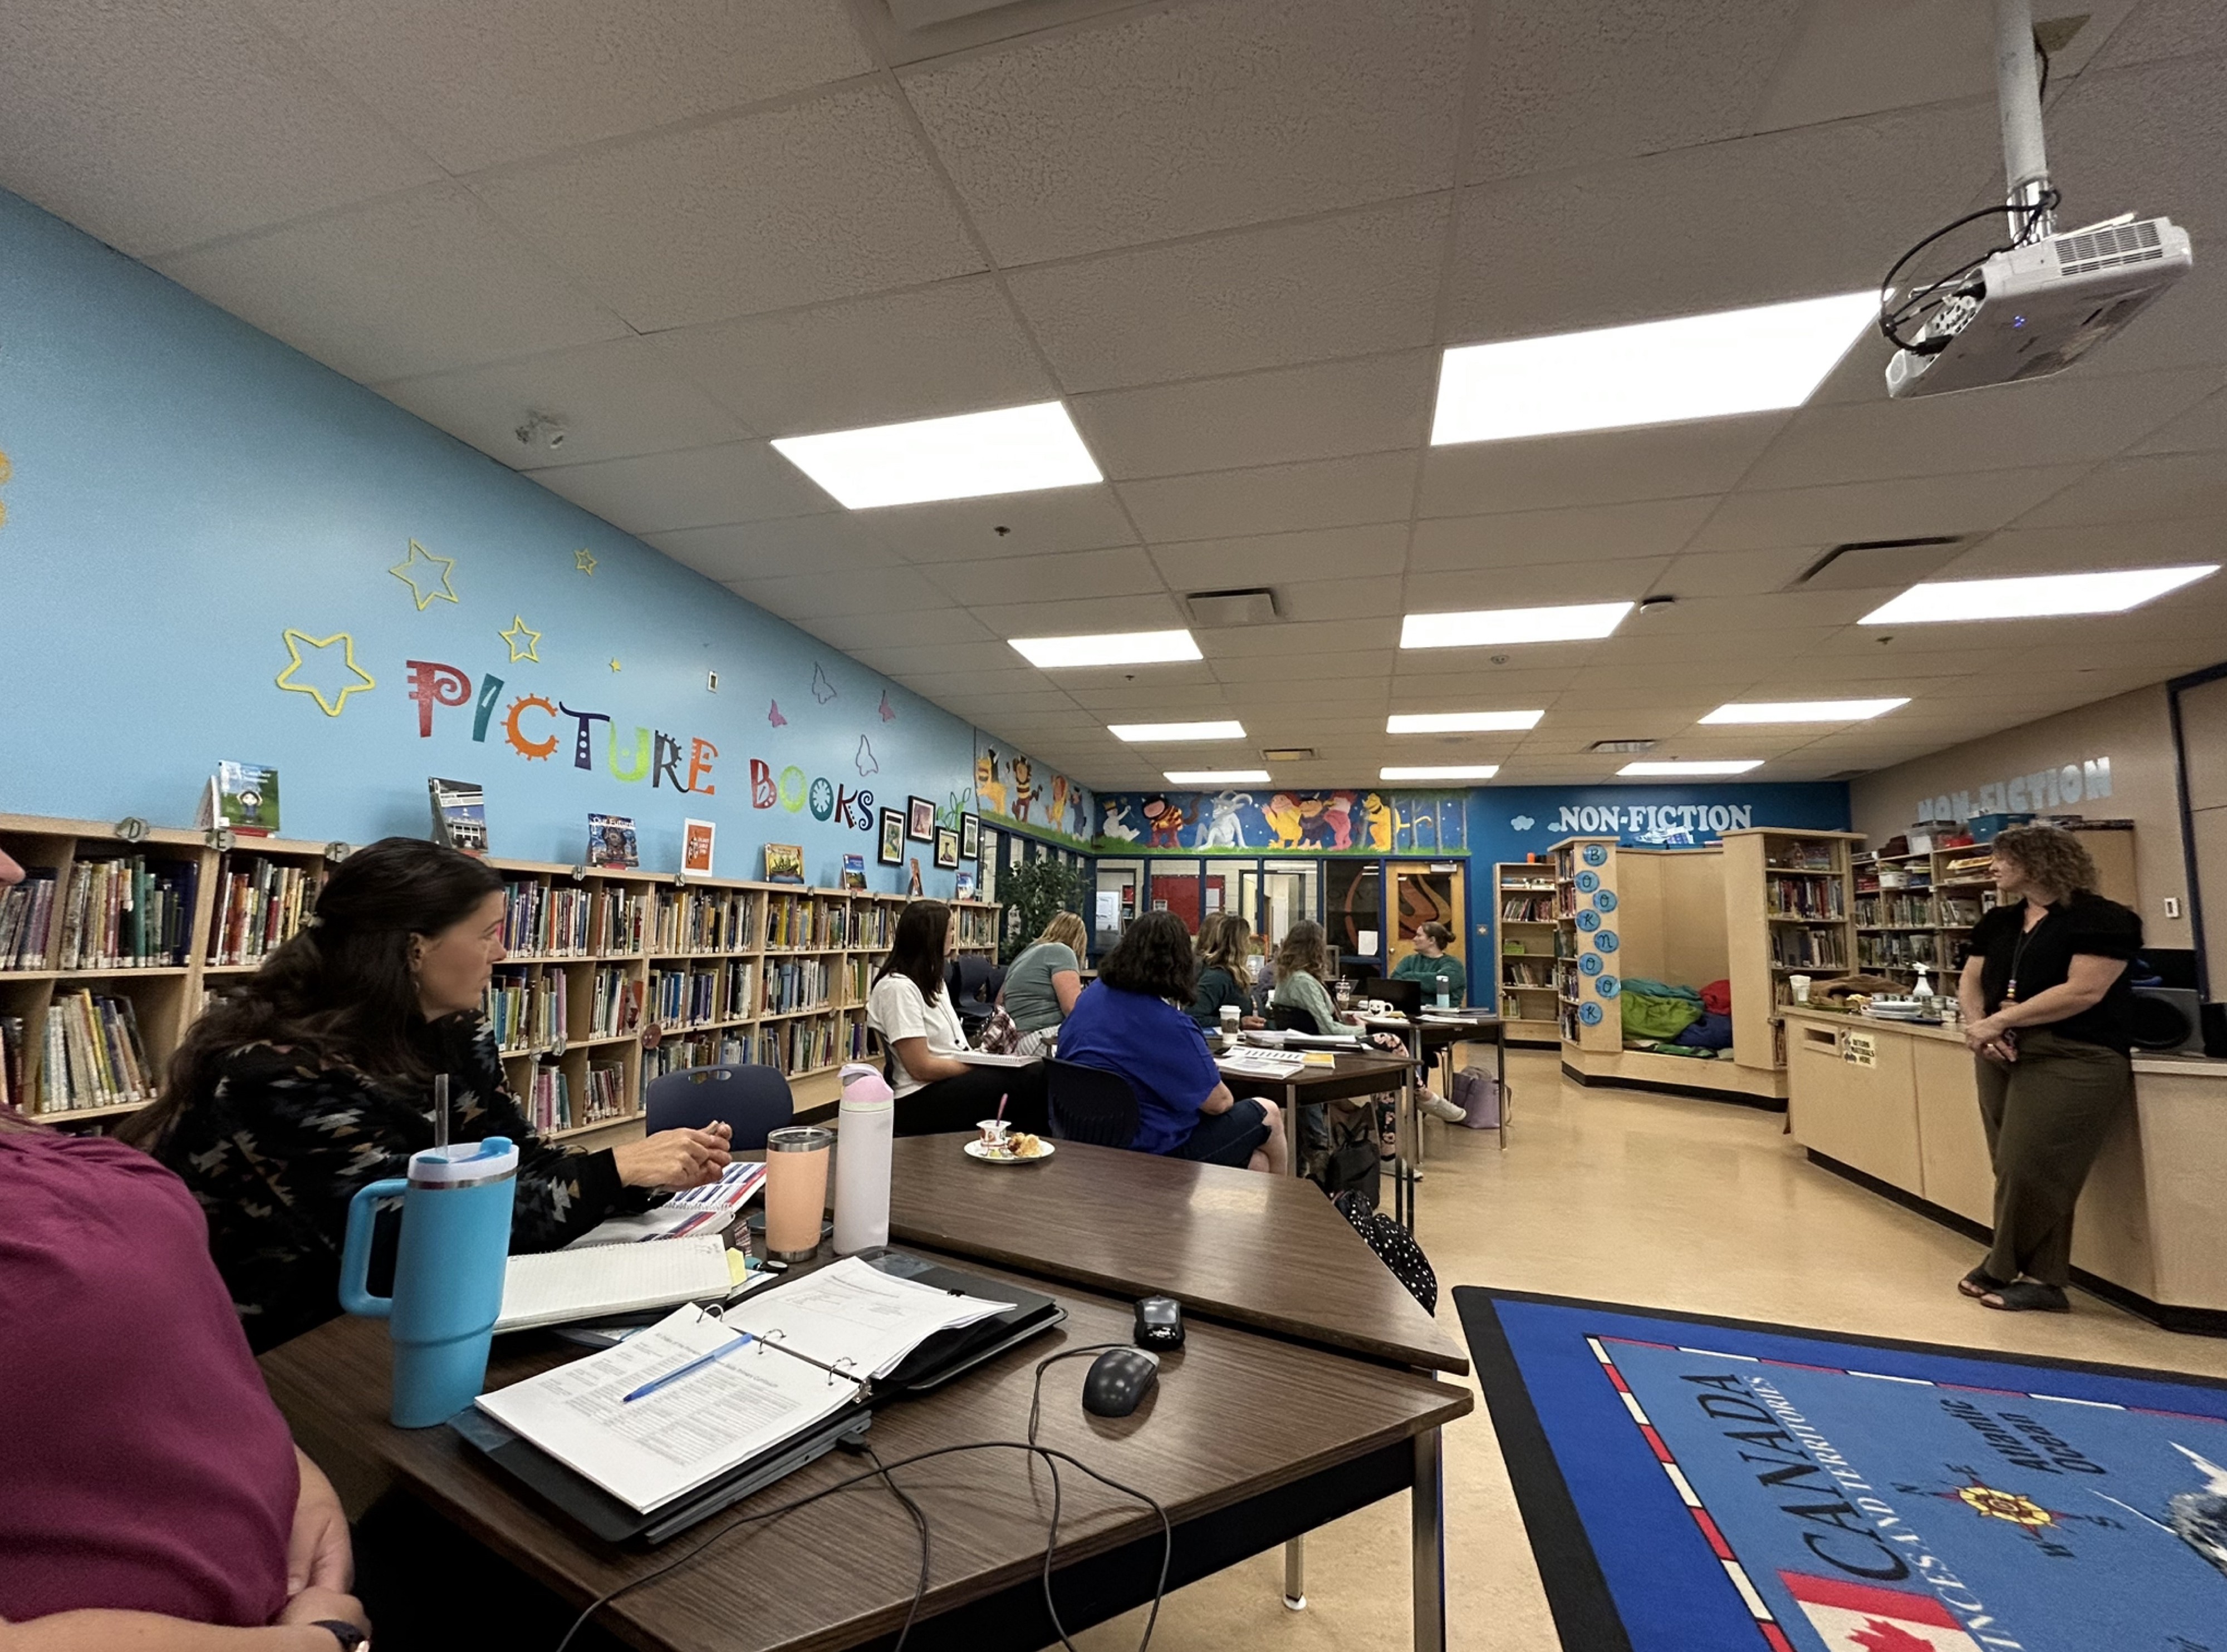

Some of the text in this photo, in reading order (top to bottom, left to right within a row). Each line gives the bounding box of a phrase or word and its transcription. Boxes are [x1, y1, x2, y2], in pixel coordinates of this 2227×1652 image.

[406, 660, 874, 831] PICTURE BOOKS
[1559, 805, 1752, 832] NON-FICTION
[1917, 756, 2112, 823] NON-FICTION
[127, 819, 141, 839] D
[217, 830, 227, 849] E
[335, 843, 344, 861] F
[1582, 848, 1610, 927] BOOK
[1743, 1375, 1873, 1491] TERRITORIES
[1940, 1398, 2064, 1475] Atlantic
[1997, 1412, 2107, 1475] Ocean
[1679, 1374, 1910, 1581] CANADA
[1857, 1497, 1931, 1551] AND
